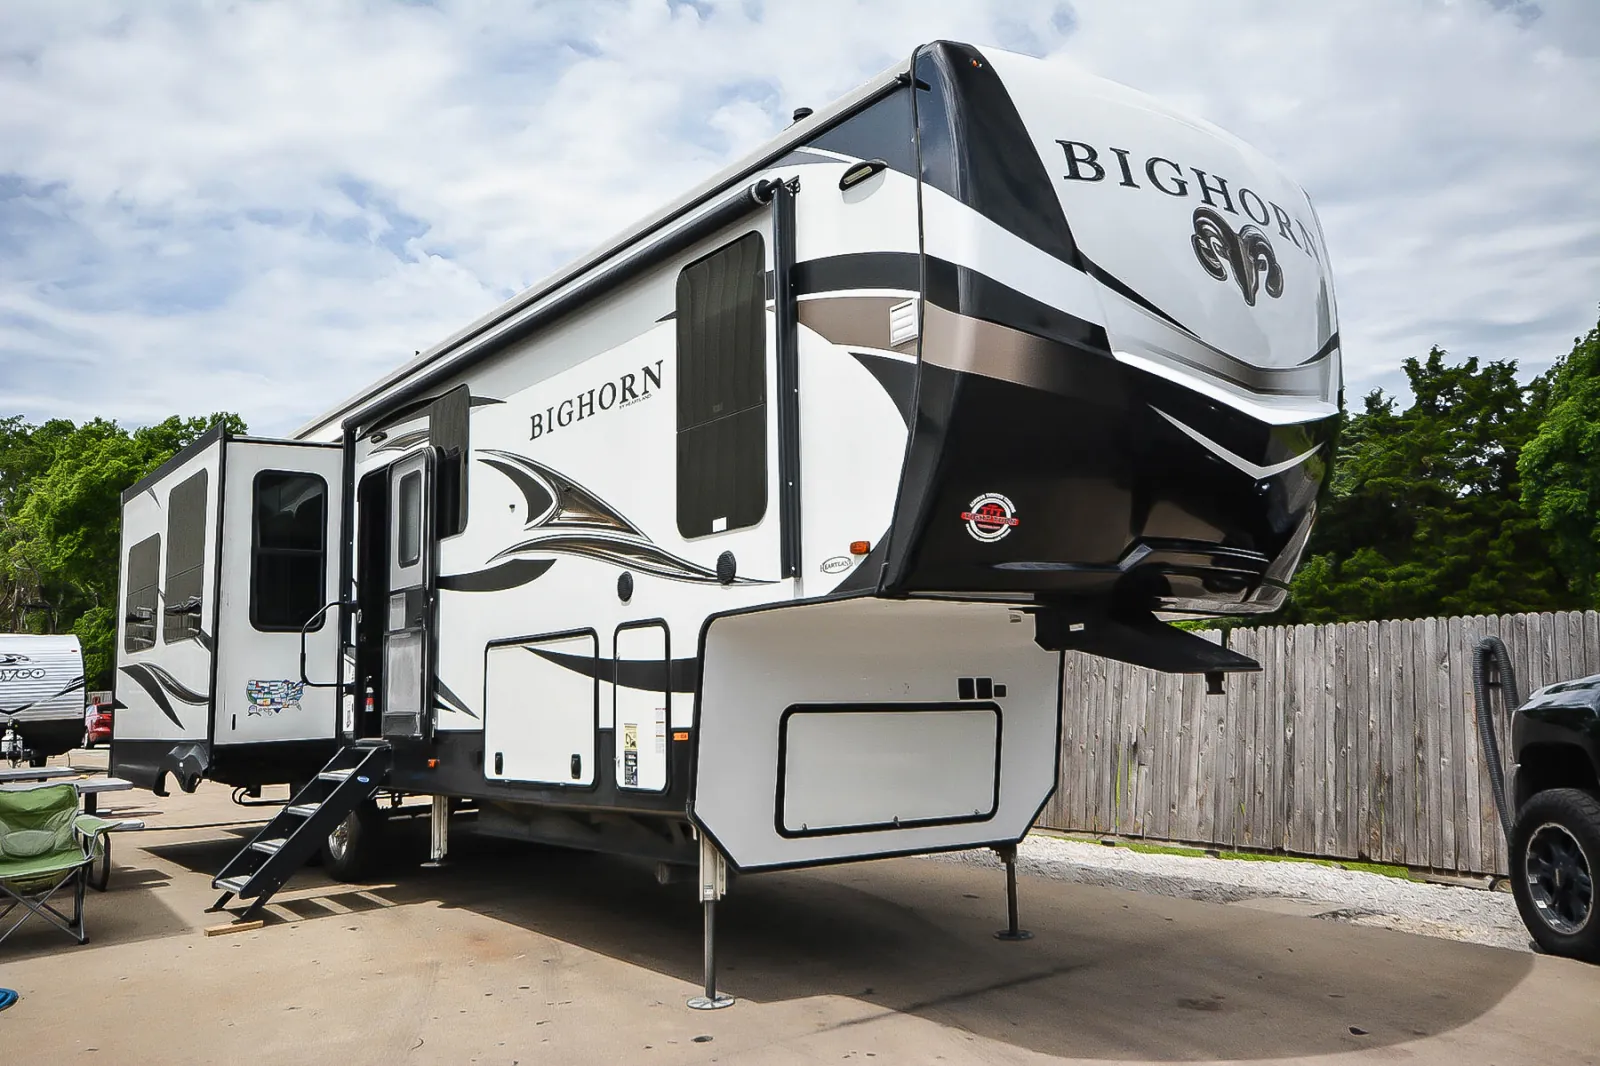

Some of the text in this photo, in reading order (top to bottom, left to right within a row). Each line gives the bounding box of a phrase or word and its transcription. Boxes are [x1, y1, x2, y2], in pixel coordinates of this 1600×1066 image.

[1055, 139, 1320, 266] BIGHORN
[529, 360, 664, 441] BIGHORN
[0, 668, 45, 682] yco
